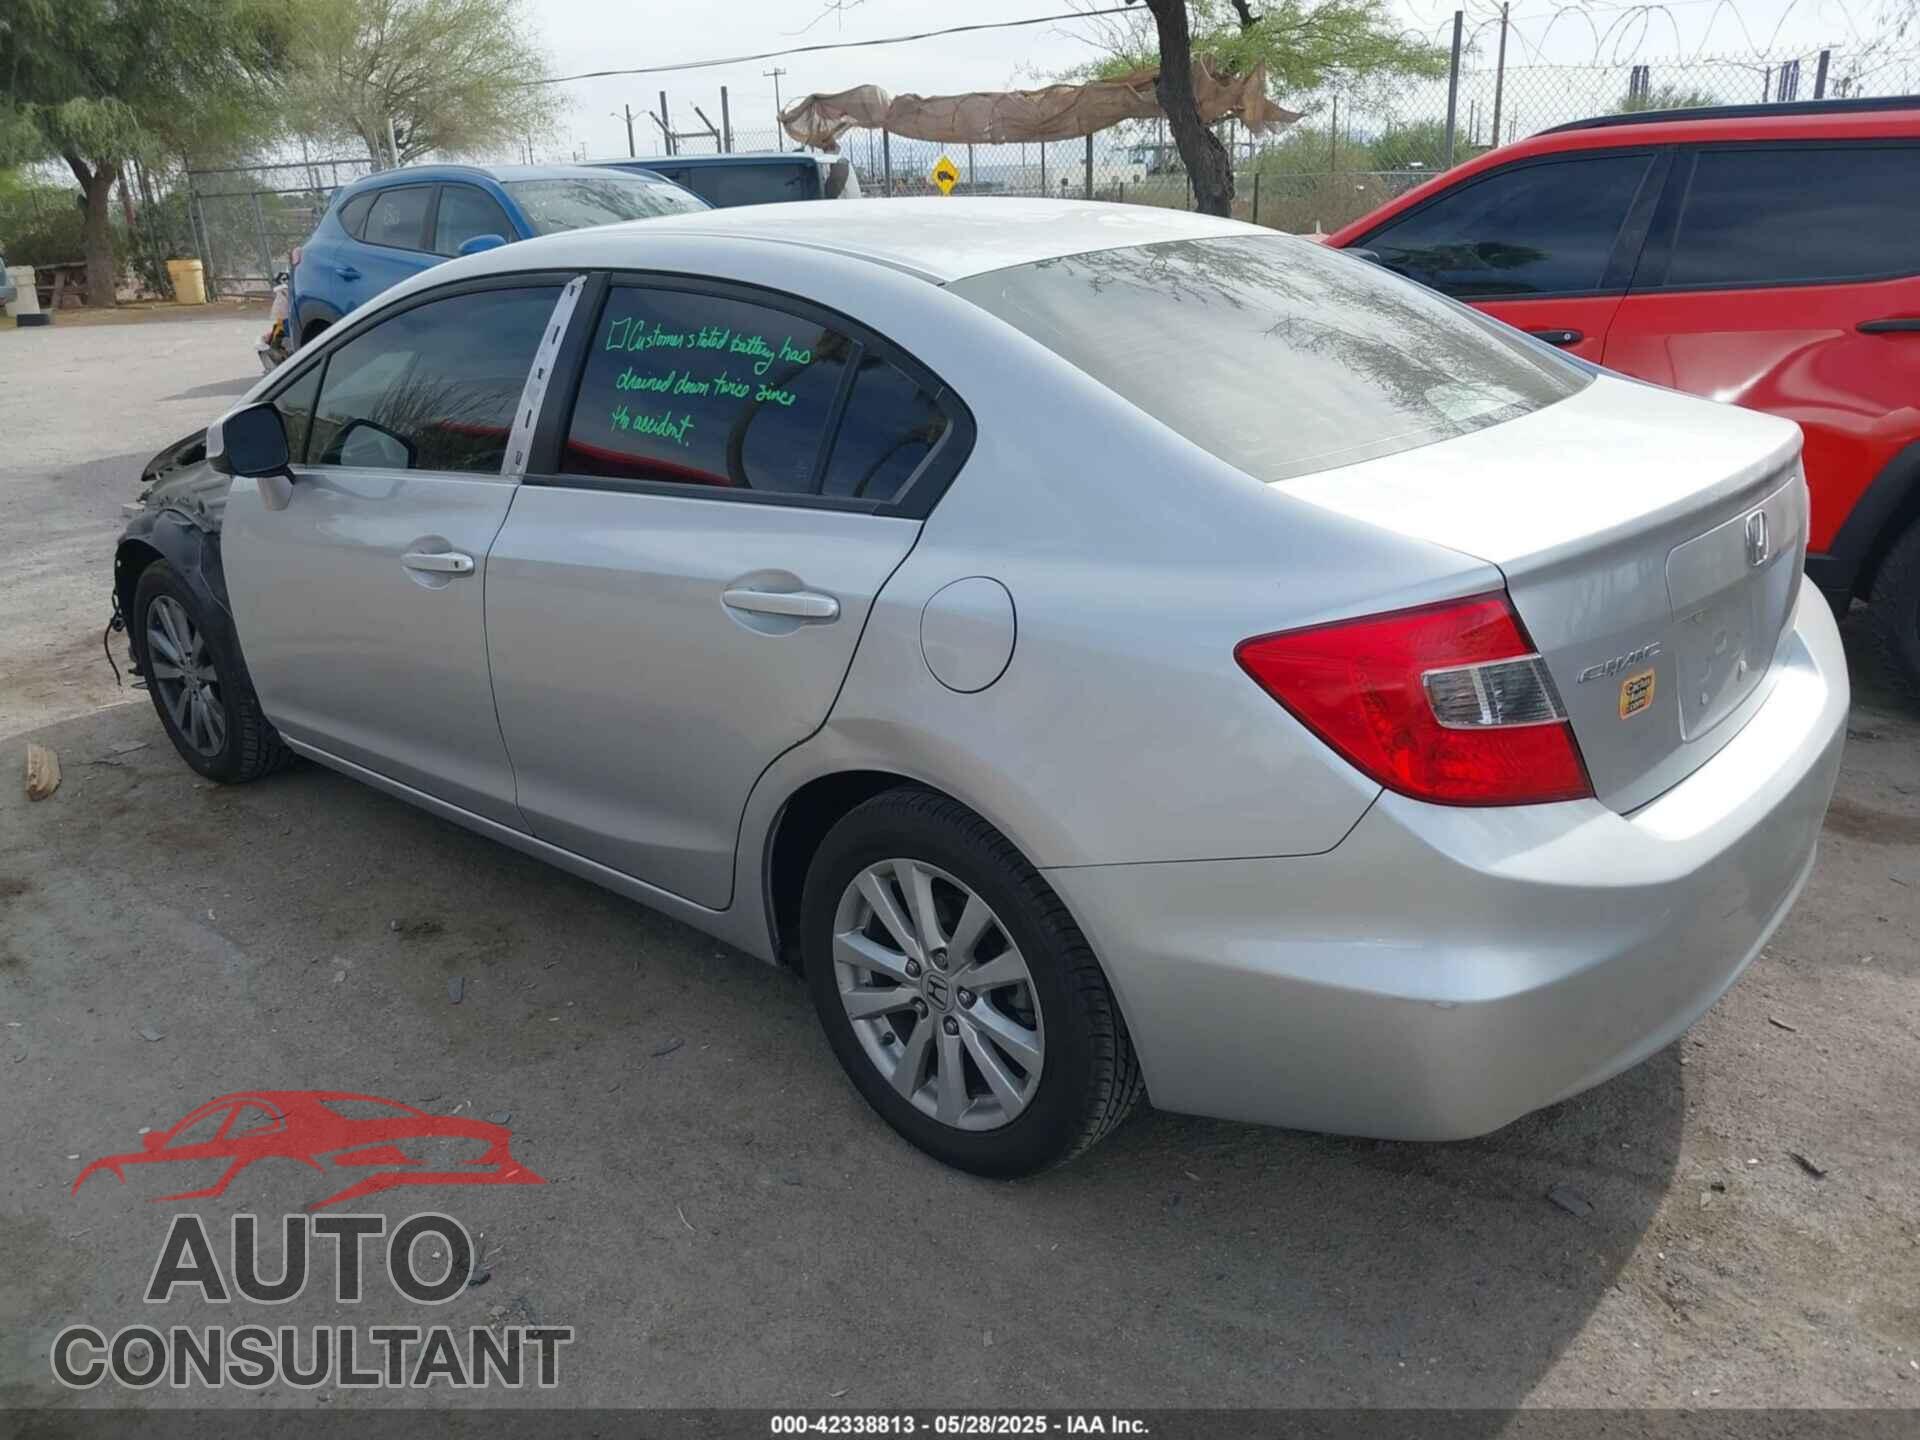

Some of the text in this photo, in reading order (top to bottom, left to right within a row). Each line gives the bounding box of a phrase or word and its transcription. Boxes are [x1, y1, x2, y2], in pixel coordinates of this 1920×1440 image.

[778, 335, 811, 365] has
[616, 366, 675, 392] drained
[673, 370, 710, 397] down
[715, 371, 749, 398] twice
